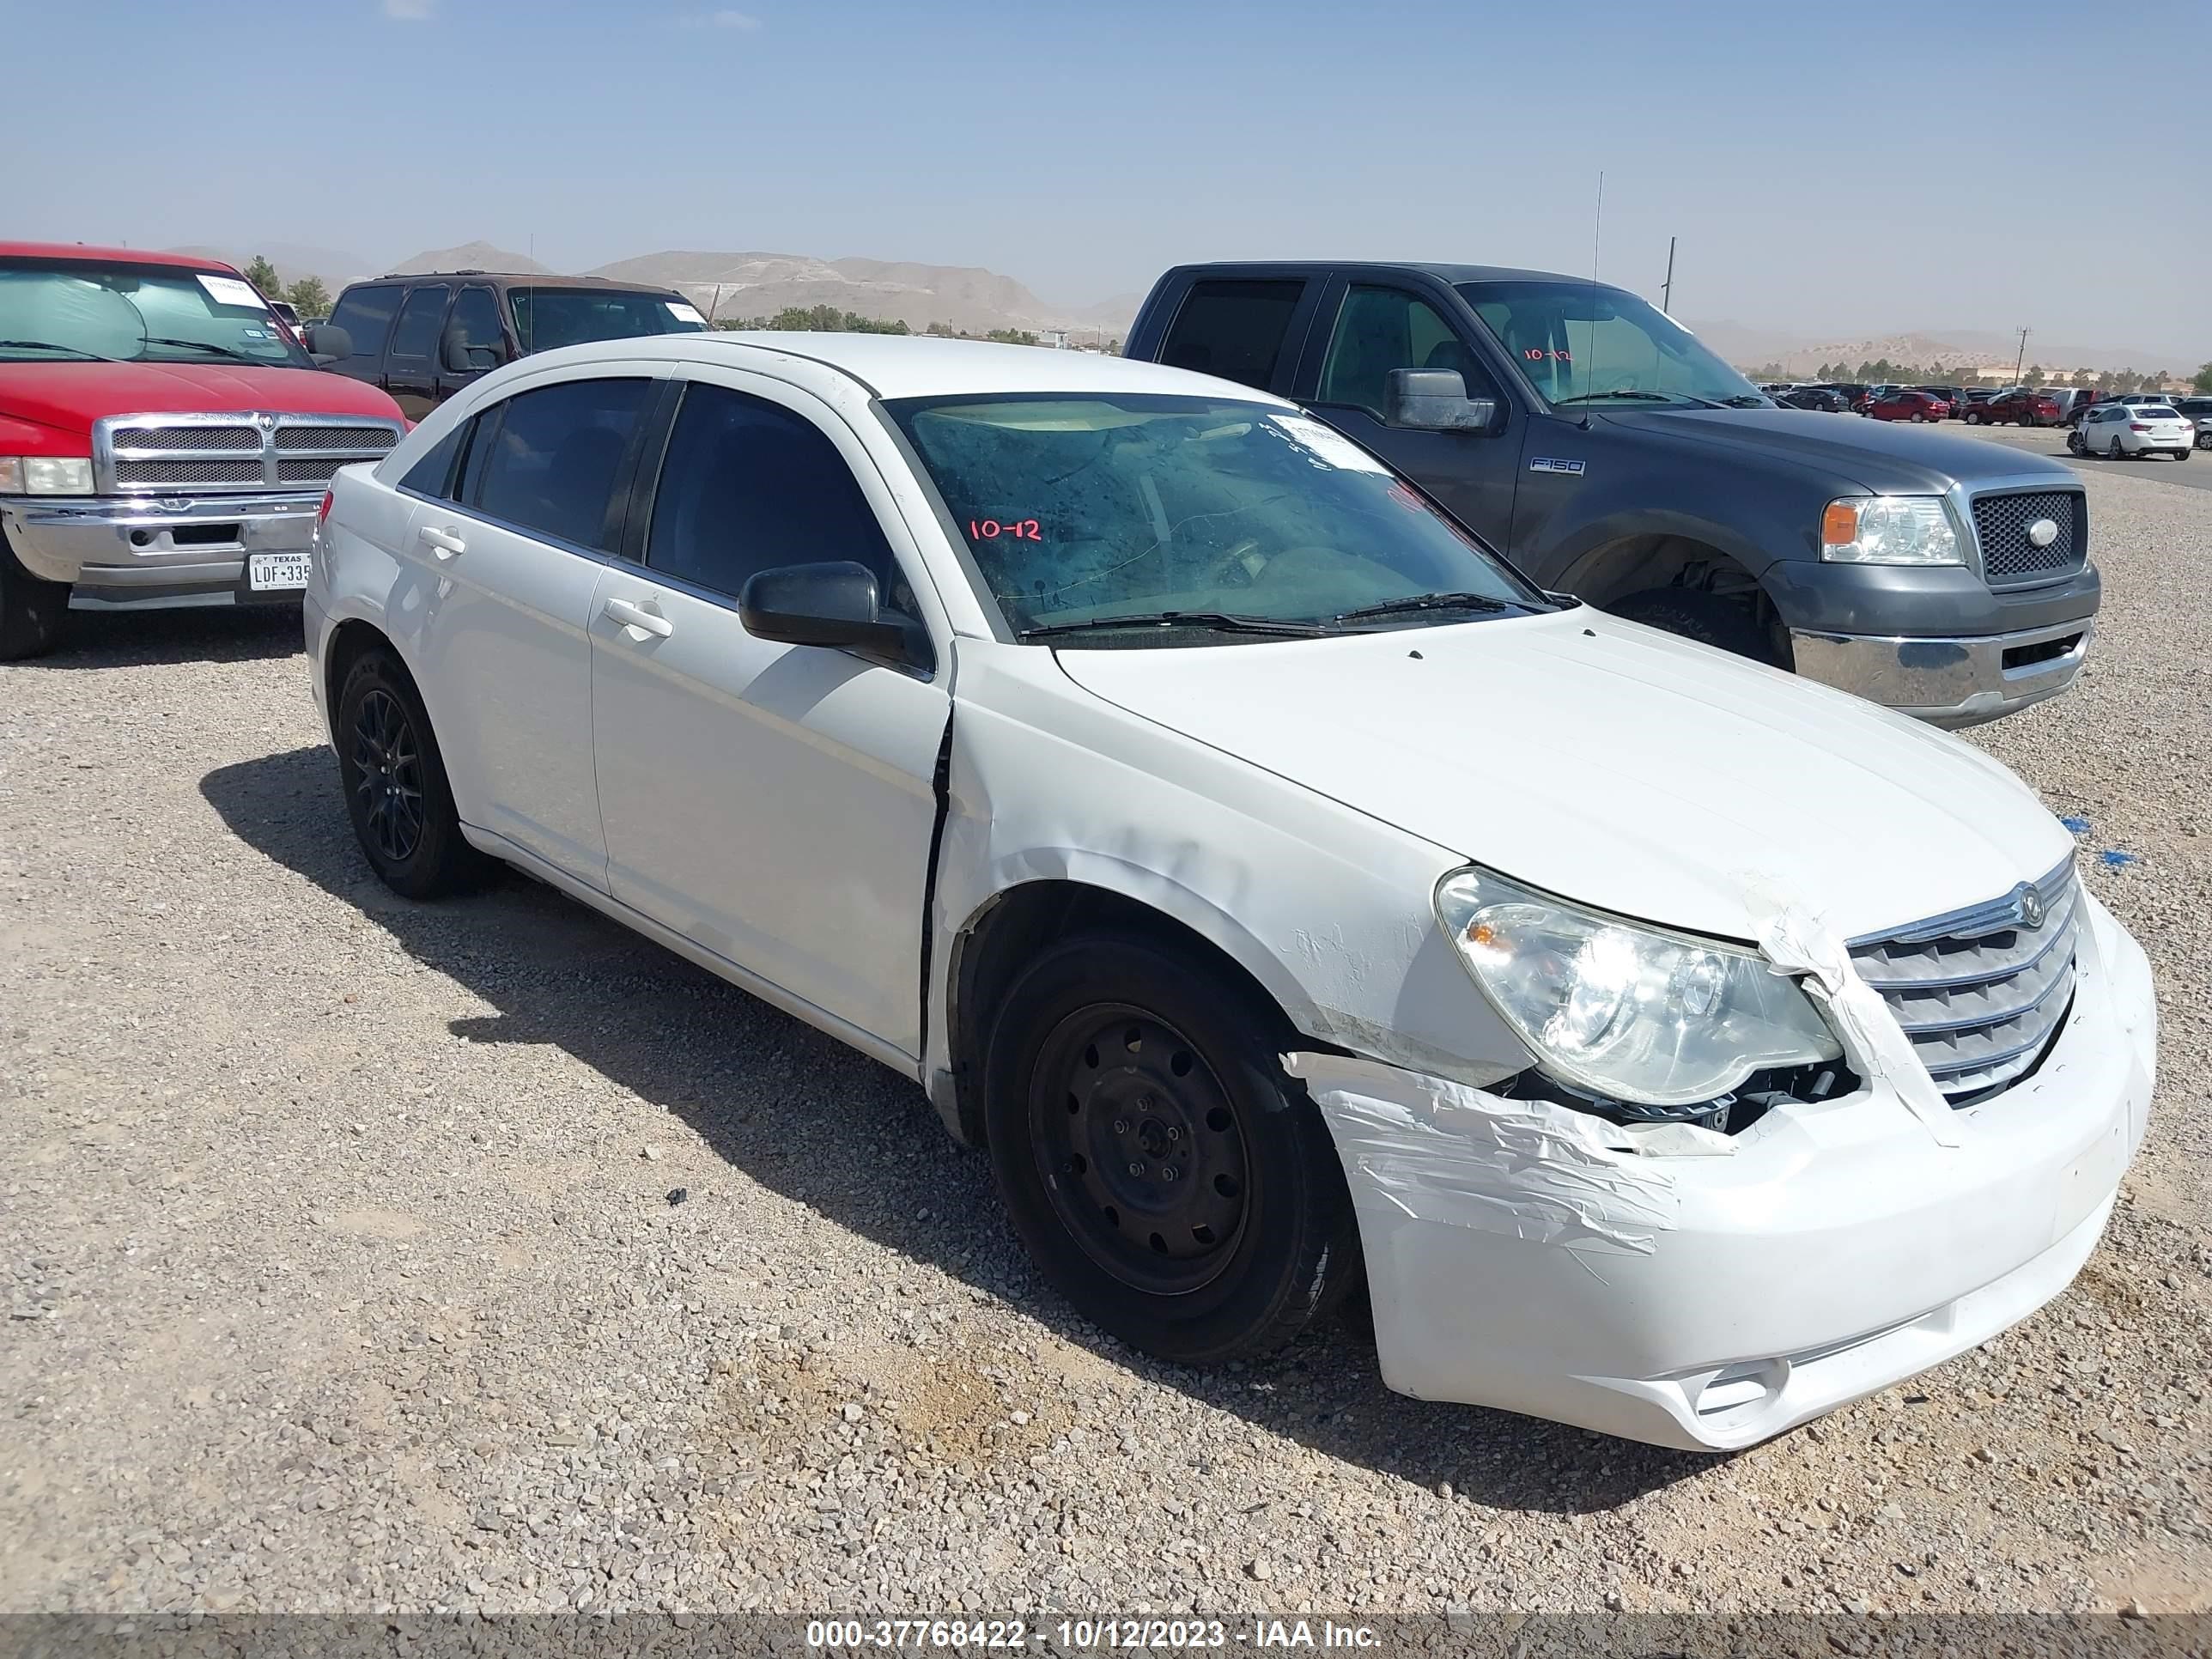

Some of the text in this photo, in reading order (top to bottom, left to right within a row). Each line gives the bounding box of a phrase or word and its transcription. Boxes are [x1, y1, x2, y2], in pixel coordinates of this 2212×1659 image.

[1524, 349, 1574, 362] 10-12
[1531, 459, 1583, 471] F-150
[970, 520, 1042, 541] 10-12
